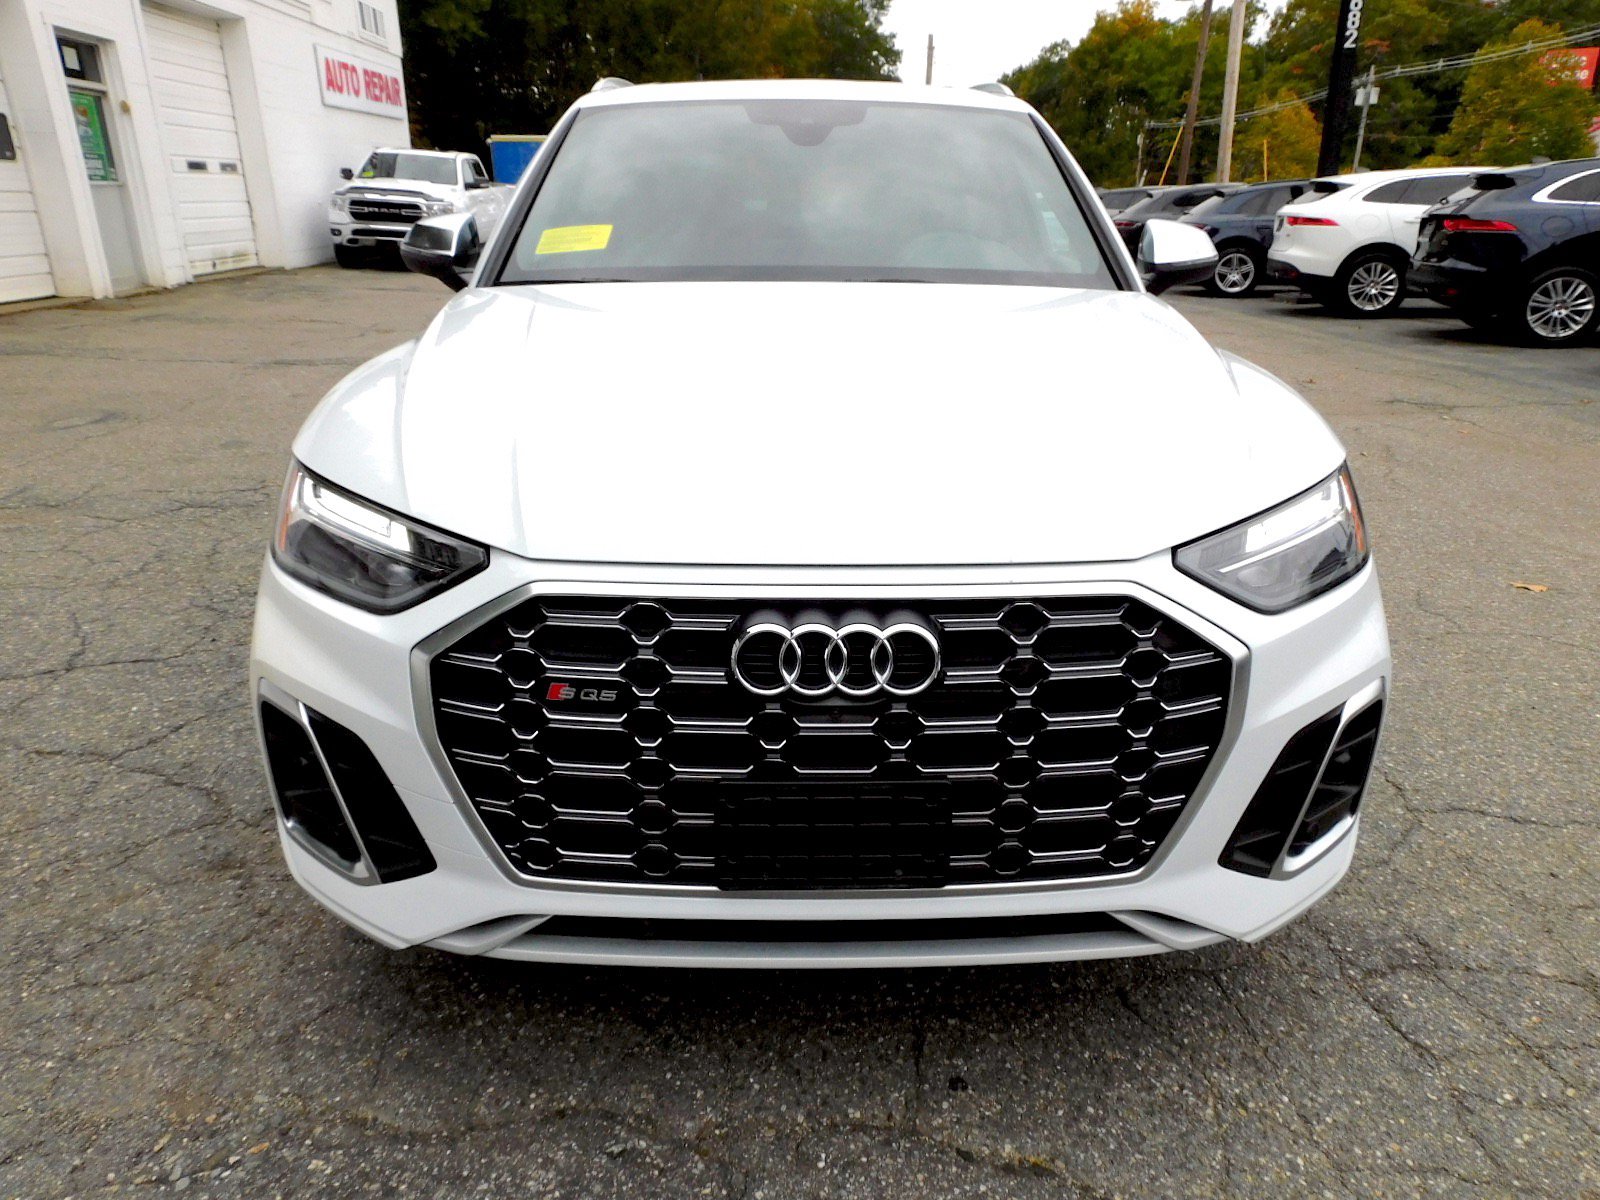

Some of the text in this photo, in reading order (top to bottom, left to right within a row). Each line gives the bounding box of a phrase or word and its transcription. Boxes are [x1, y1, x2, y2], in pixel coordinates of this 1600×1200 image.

[324, 56, 403, 107] AUTO REPAIR
[367, 206, 400, 214] RAM
